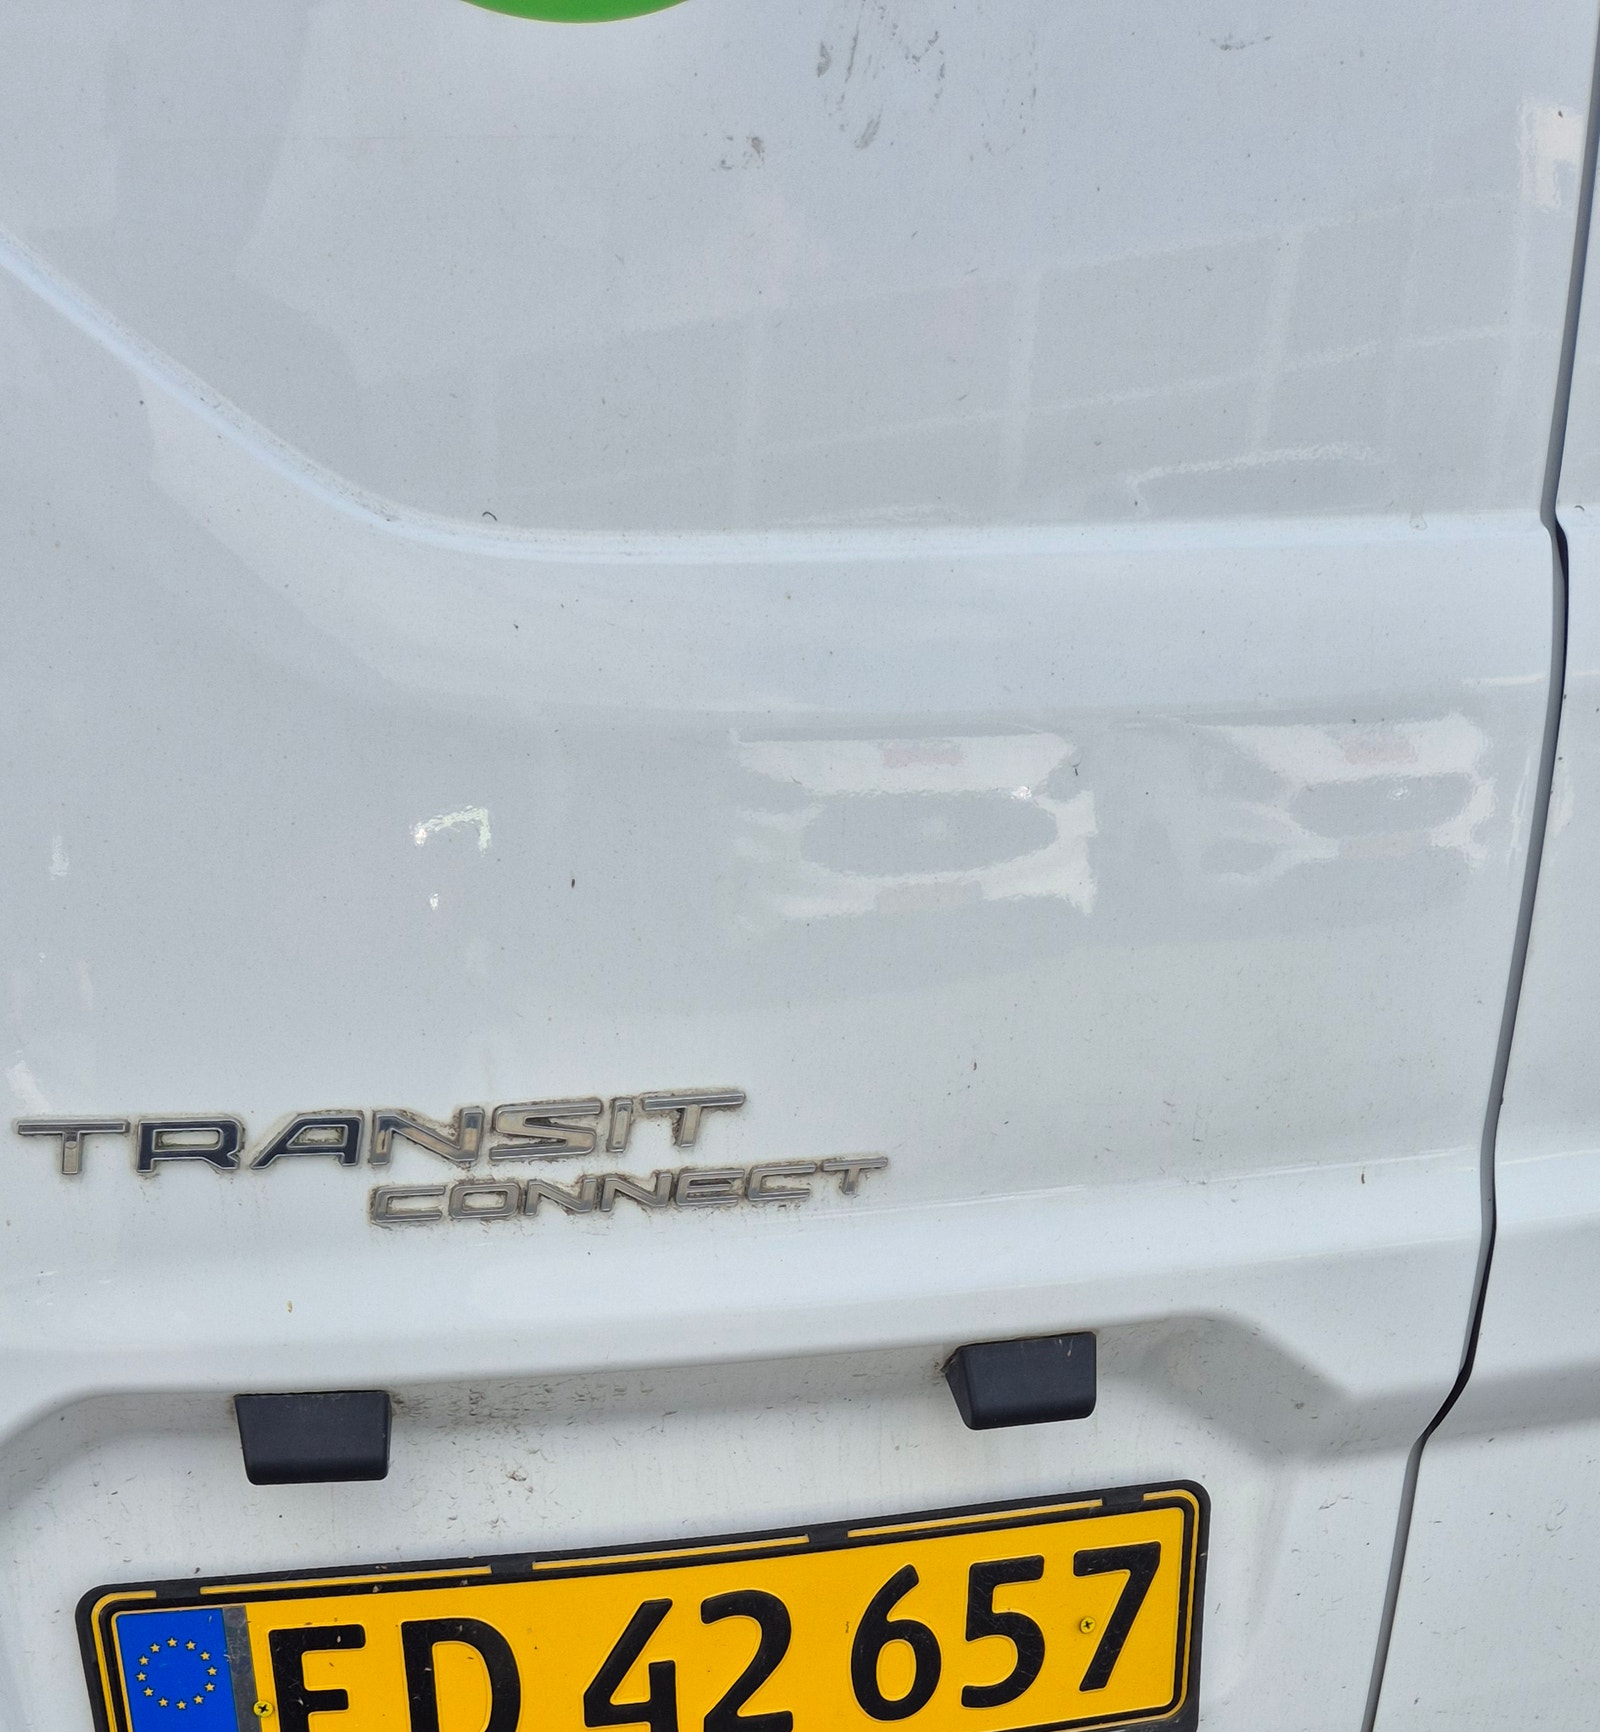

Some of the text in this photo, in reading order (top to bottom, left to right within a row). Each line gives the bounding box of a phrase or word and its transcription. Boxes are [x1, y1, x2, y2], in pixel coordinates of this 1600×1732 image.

[16, 1090, 747, 1176] TRANSIT
[369, 1157, 889, 1225] CONNECT
[850, 1541, 1162, 1723] 657
